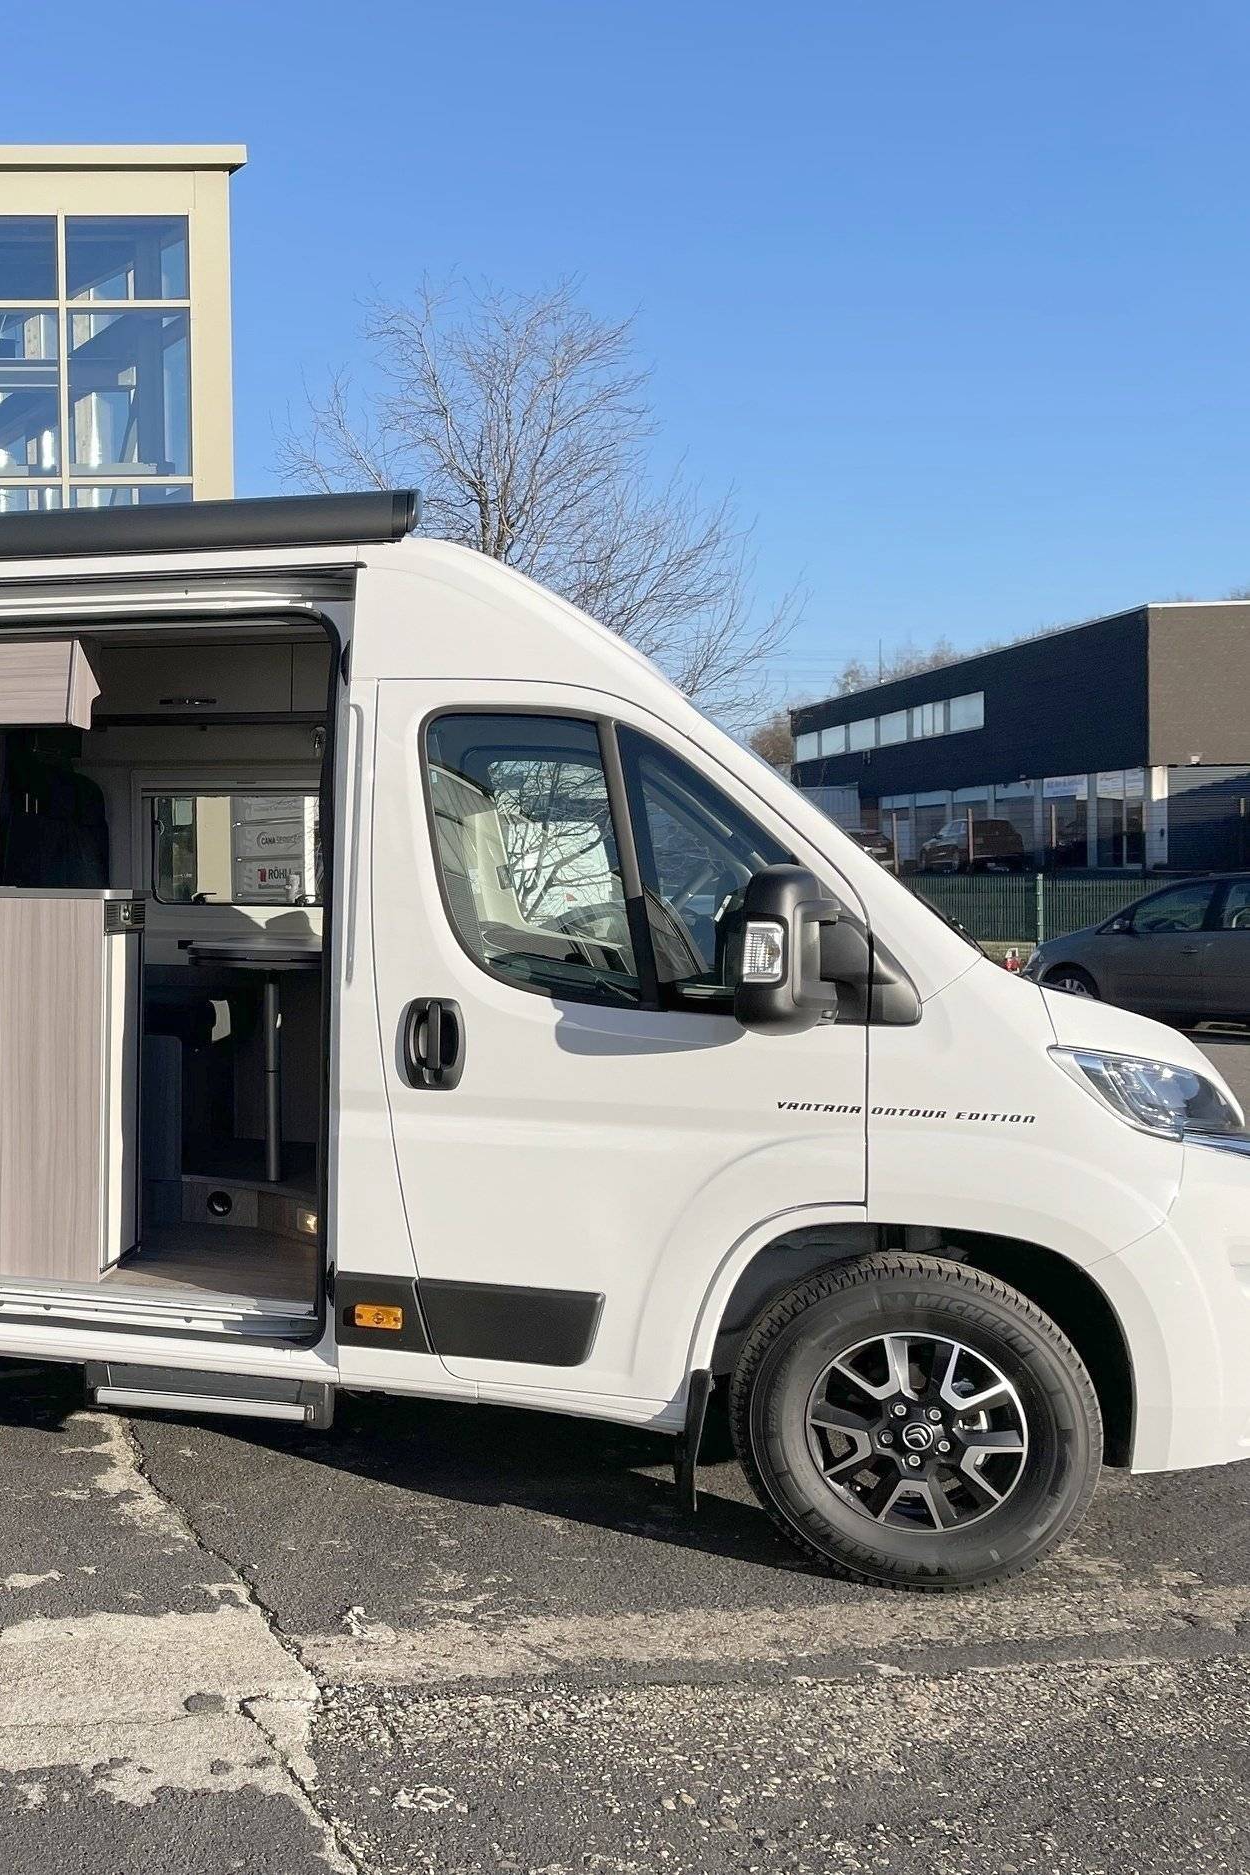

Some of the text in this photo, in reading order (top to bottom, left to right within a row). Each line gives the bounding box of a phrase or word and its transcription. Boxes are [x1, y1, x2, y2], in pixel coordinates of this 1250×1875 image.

[776, 1101, 1036, 1124] VANTANA ONTOUR EDITION
[914, 1293, 1035, 1355] MICHELIN
